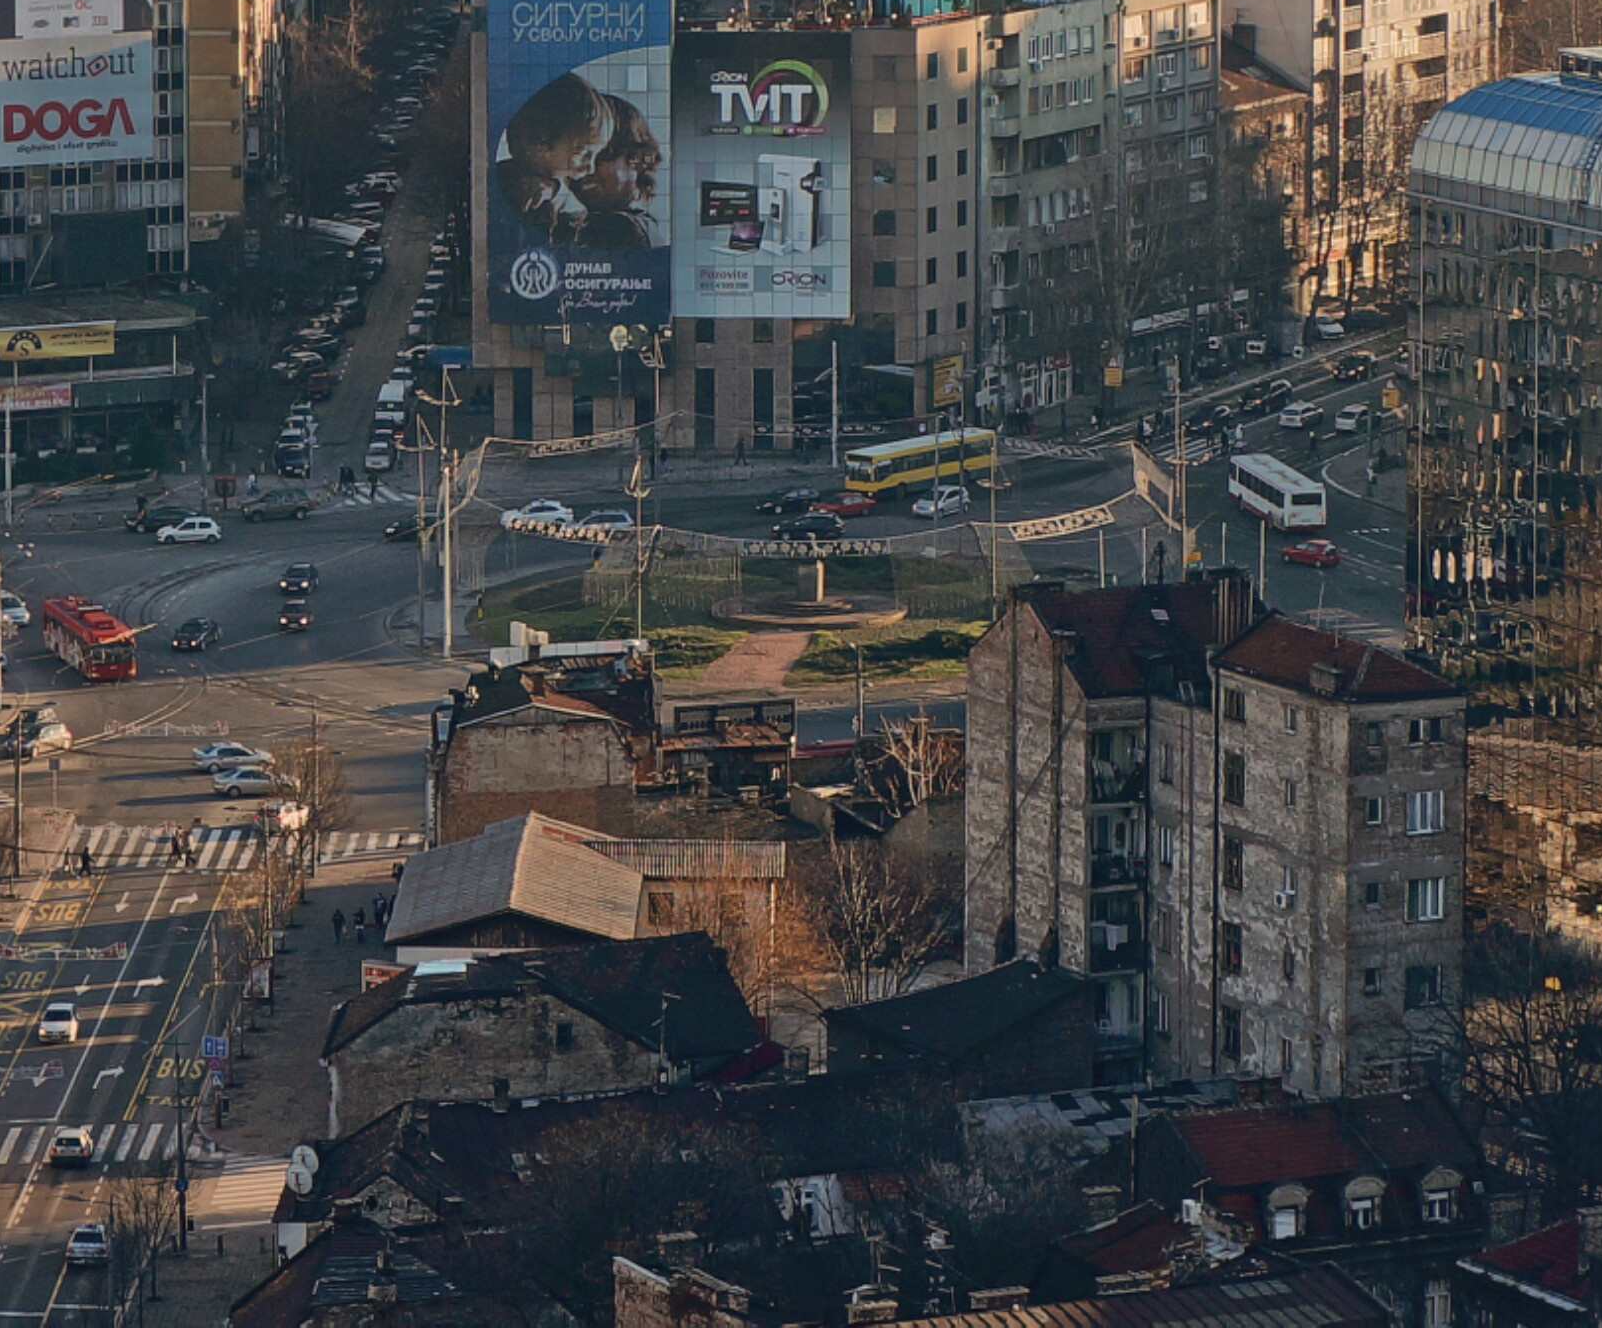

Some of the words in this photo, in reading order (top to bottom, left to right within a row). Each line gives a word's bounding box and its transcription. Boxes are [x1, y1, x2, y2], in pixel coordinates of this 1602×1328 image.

[511, 2, 645, 27] СИГУРНИ
[512, 27, 524, 42] У
[528, 27, 585, 42] СВОЈУ
[588, 27, 644, 42] СНАГУ
[3, 98, 136, 143] DOGA
[564, 262, 612, 276] ДУНАВ
[771, 270, 826, 286] ORION
[565, 278, 652, 290] ОСИГУРАЊЕ
[35, 902, 82, 922] BUS
[1, 971, 48, 990] BUS
[156, 1058, 206, 1080] BUS
